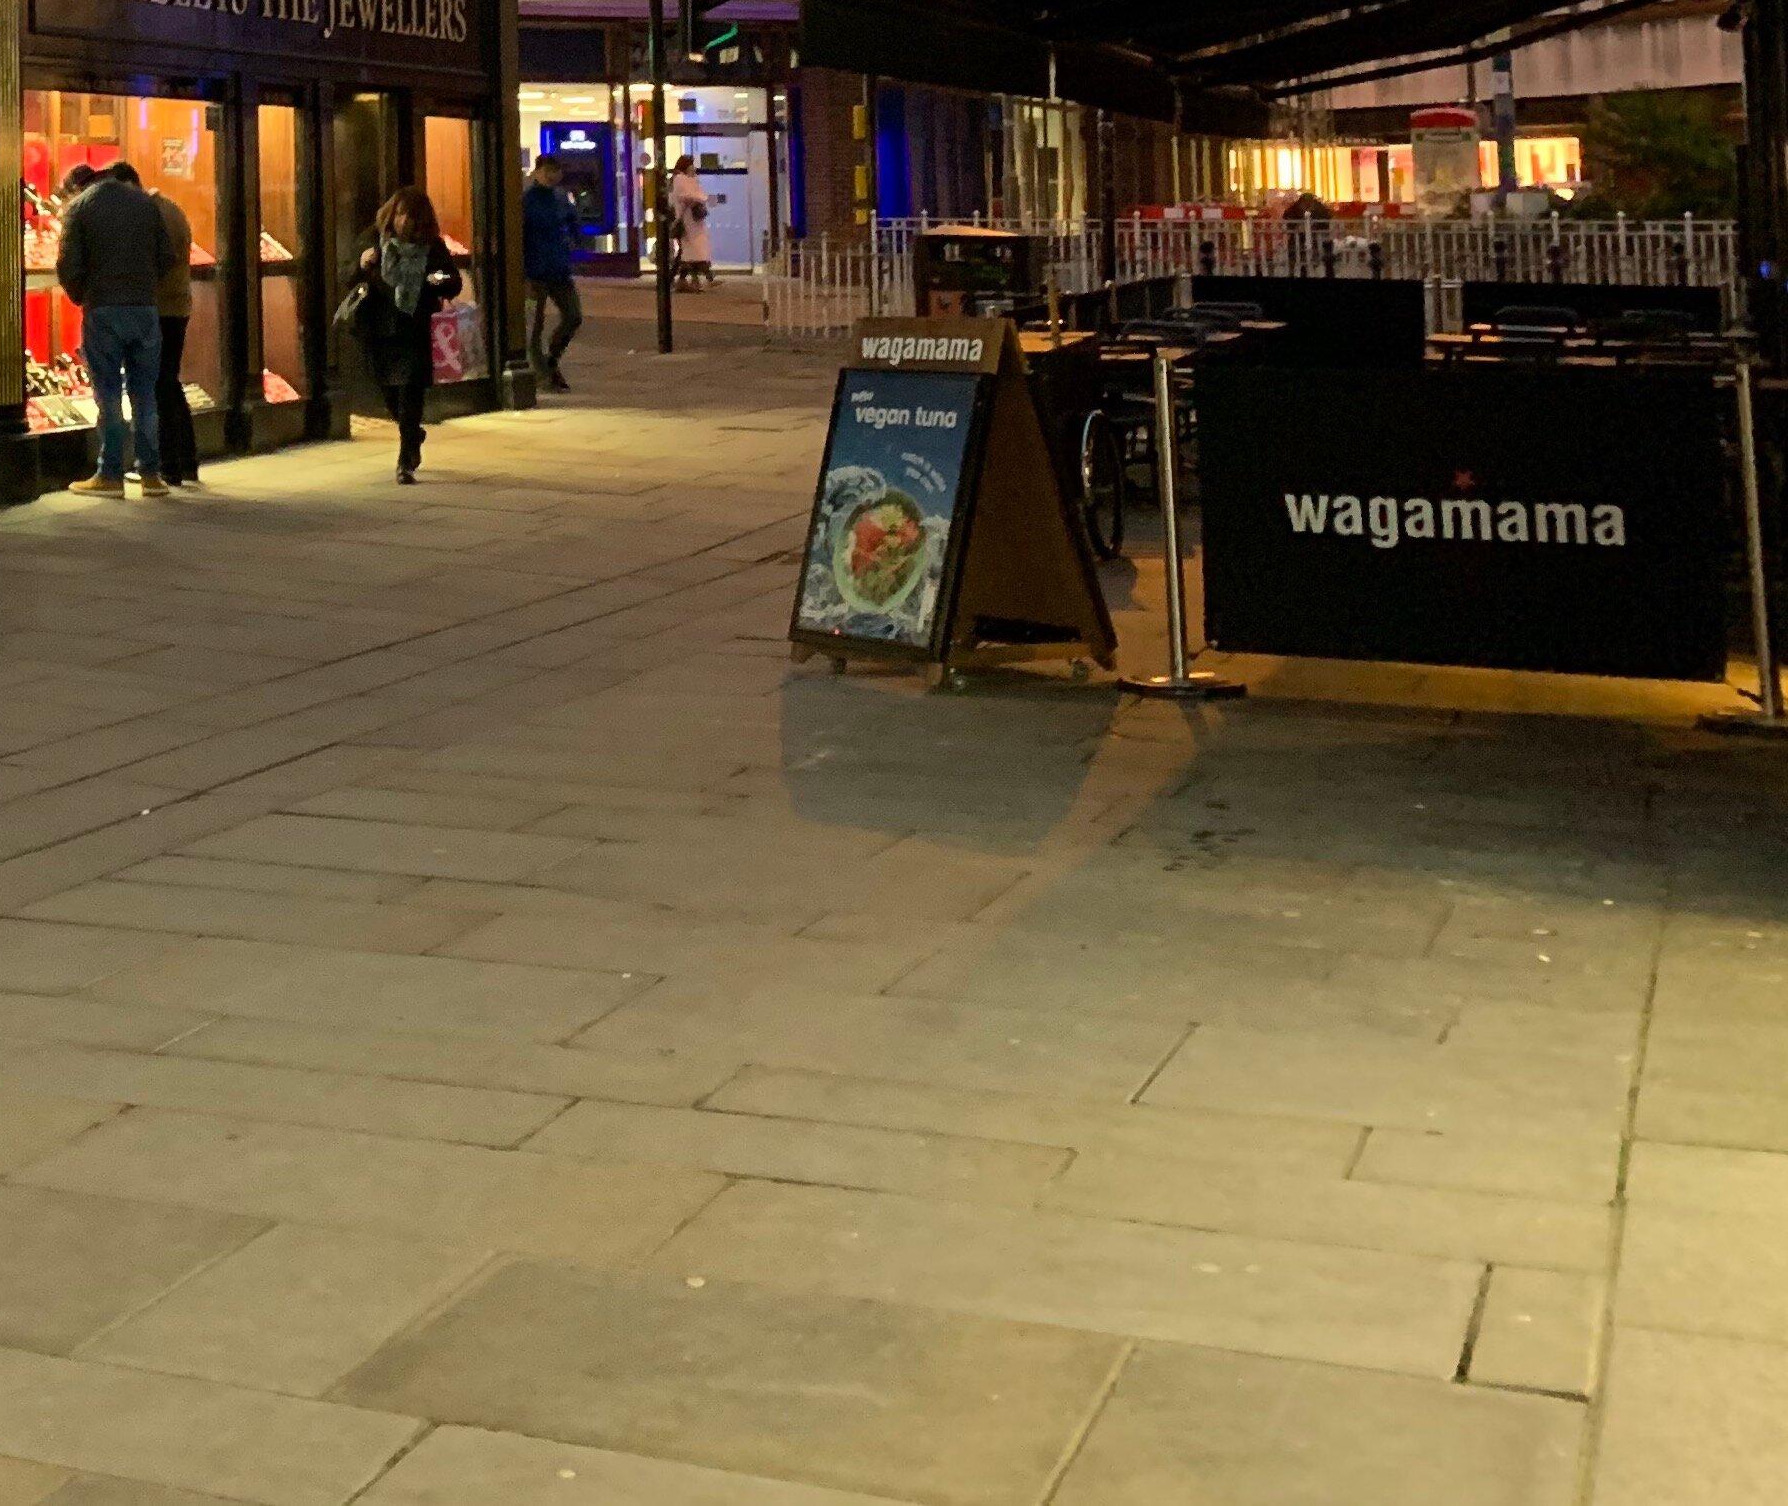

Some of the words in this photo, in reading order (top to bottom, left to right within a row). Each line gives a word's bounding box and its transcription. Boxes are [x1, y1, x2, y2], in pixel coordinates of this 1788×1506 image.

[861, 336, 983, 365] wagamama
[855, 406, 911, 430] vegan
[915, 406, 958, 428] tuna
[1284, 493, 1626, 549] wagamama
